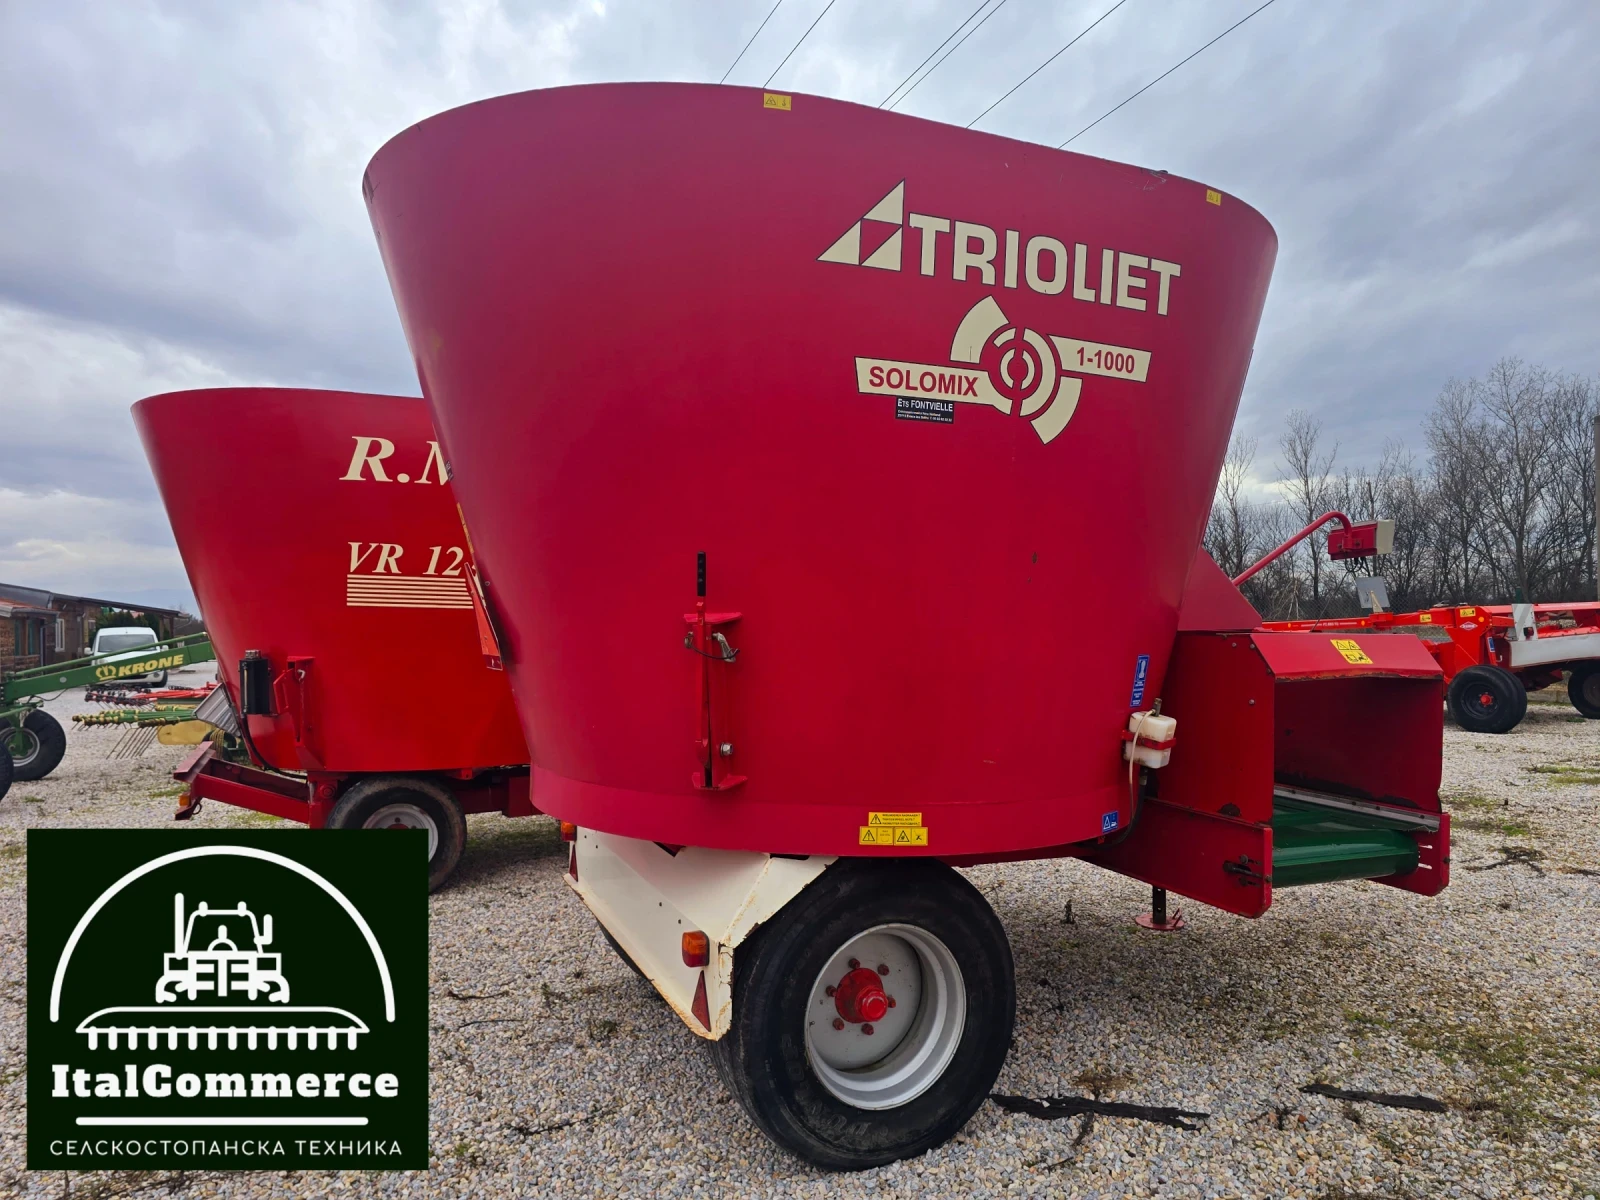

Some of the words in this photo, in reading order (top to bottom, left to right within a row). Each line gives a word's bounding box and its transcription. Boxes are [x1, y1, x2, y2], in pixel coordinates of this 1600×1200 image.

[908, 211, 1182, 317] TRIOLIET
[1076, 346, 1136, 375] 1-1000
[868, 366, 979, 398] SOLOMIX
[910, 399, 954, 412] FONTVIELLE
[347, 541, 404, 575] VR
[118, 654, 184, 677] KRONE
